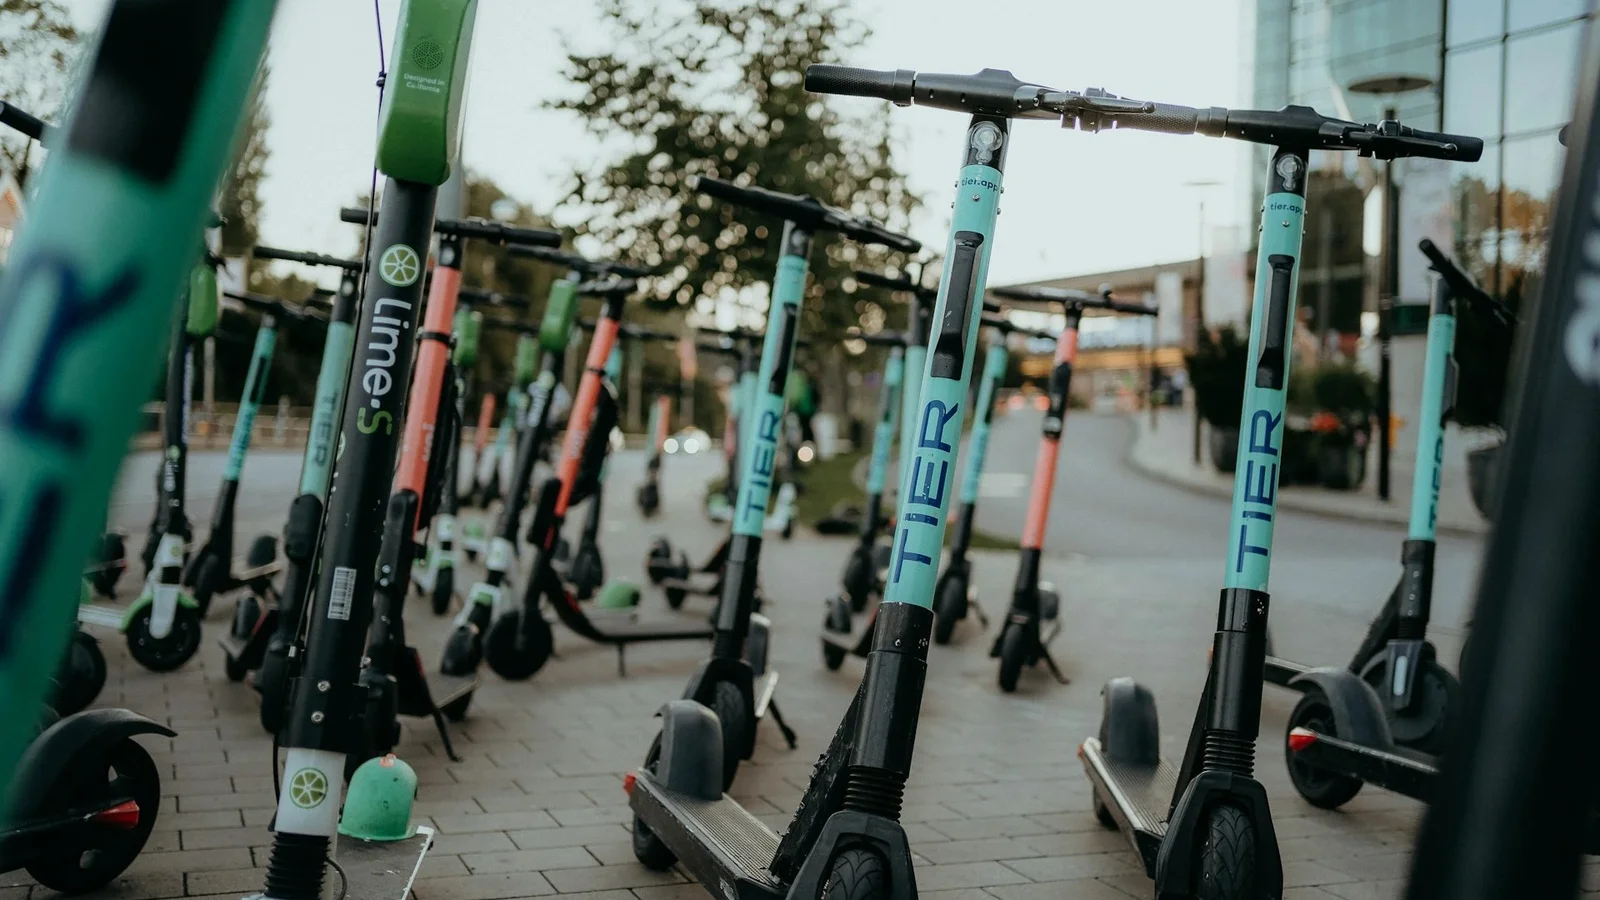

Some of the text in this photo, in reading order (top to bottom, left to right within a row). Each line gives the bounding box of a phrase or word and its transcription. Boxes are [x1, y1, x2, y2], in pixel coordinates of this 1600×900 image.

[403, 72, 437, 84] Designed
[406, 81, 440, 93] Caifornia
[743, 408, 779, 522] TIER
[893, 399, 959, 584] TIER
[1236, 409, 1282, 573] TIER
